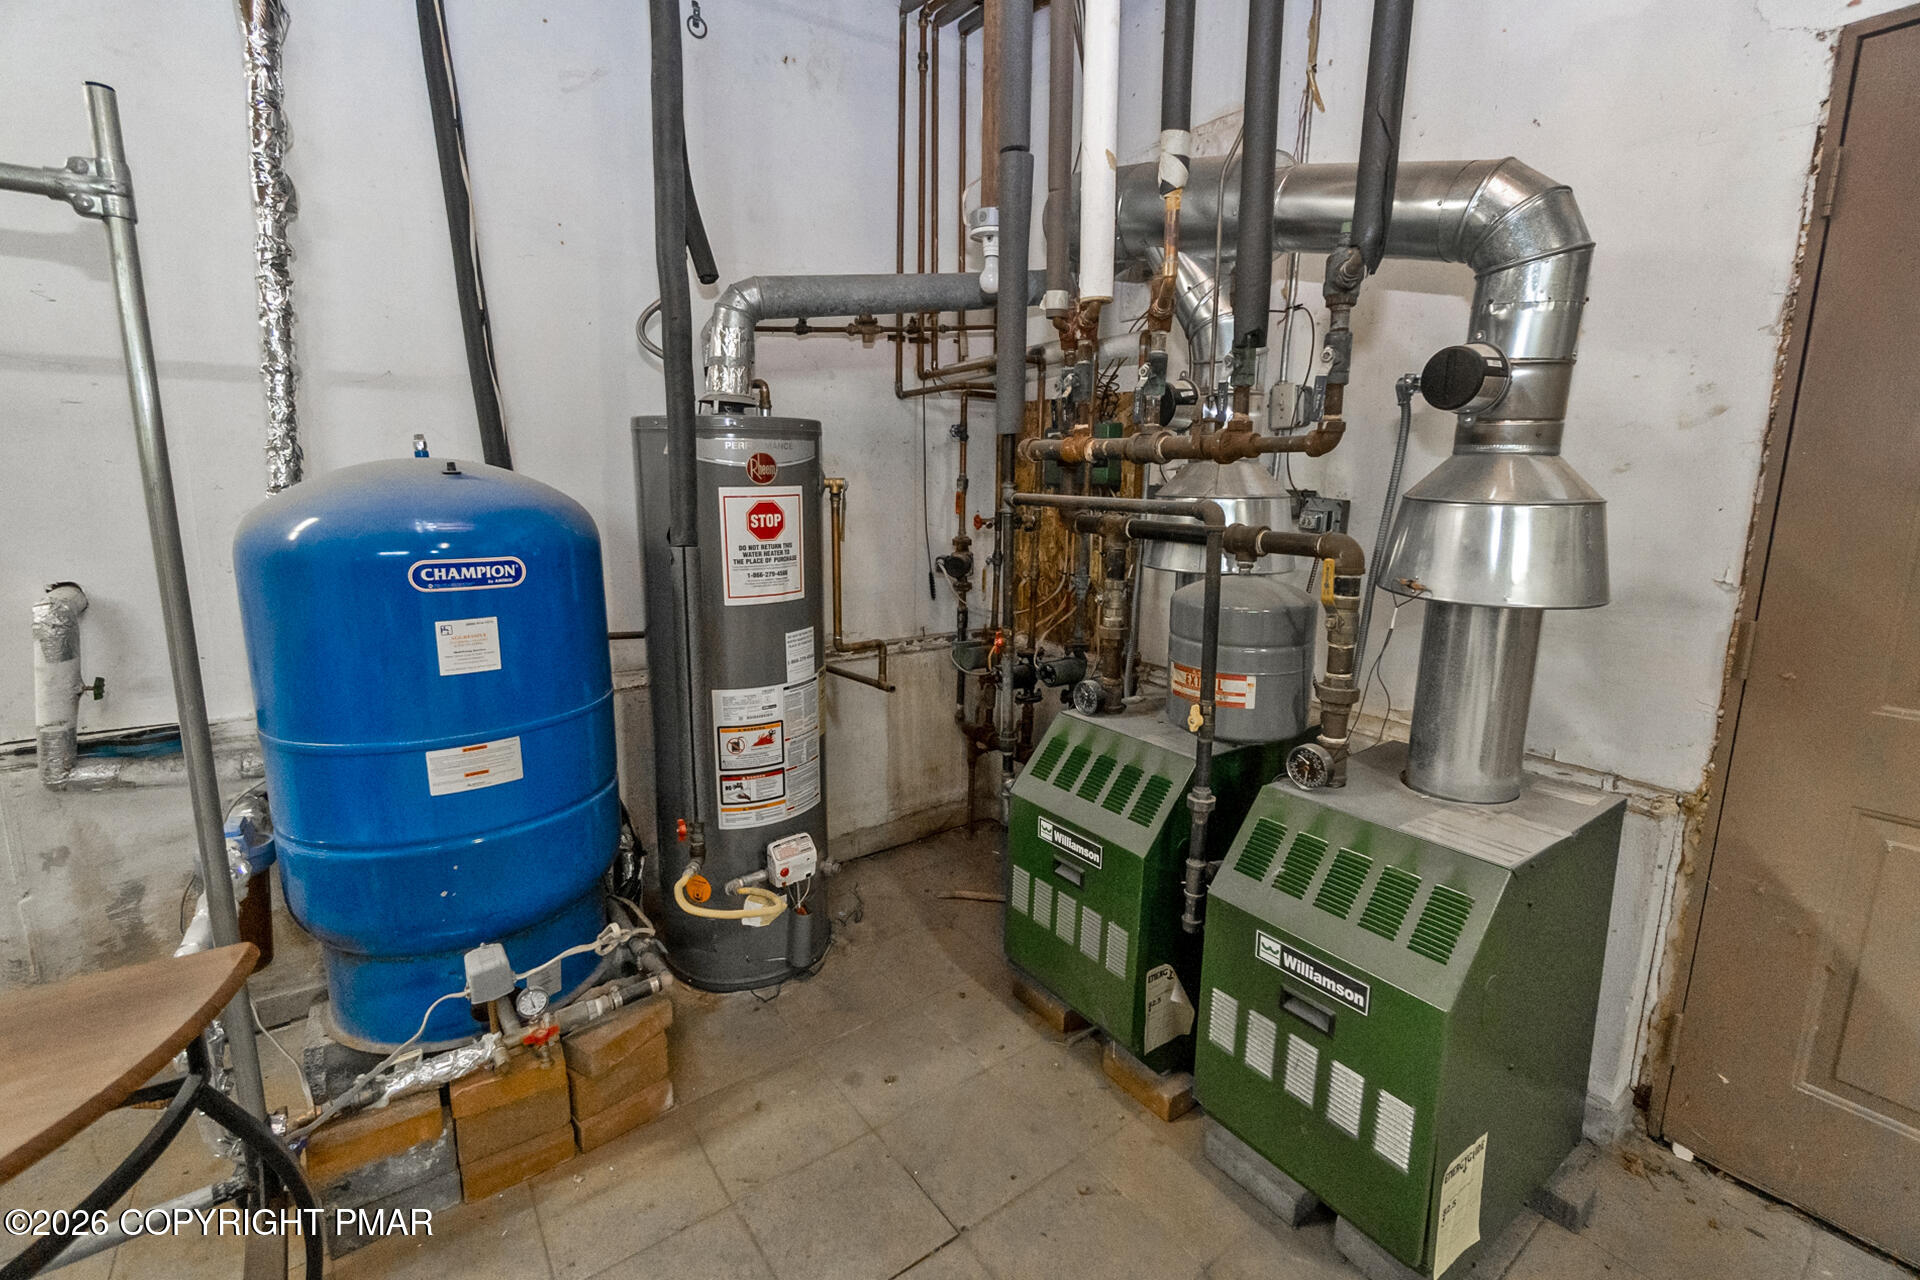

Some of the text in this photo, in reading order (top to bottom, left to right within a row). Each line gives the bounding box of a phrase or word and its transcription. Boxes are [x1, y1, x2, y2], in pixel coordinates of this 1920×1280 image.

[750, 452, 776, 480] Rheem
[750, 513, 782, 528] STOP
[742, 550, 762, 558] WATER
[763, 549, 783, 557] HEATER
[745, 557, 764, 565] PLACE
[773, 555, 797, 563] PURCHASE
[420, 564, 516, 581] CHAMPION
[1185, 671, 1223, 692] EXTL
[1053, 829, 1100, 863] Williamson
[1283, 951, 1365, 1007] Williamson
